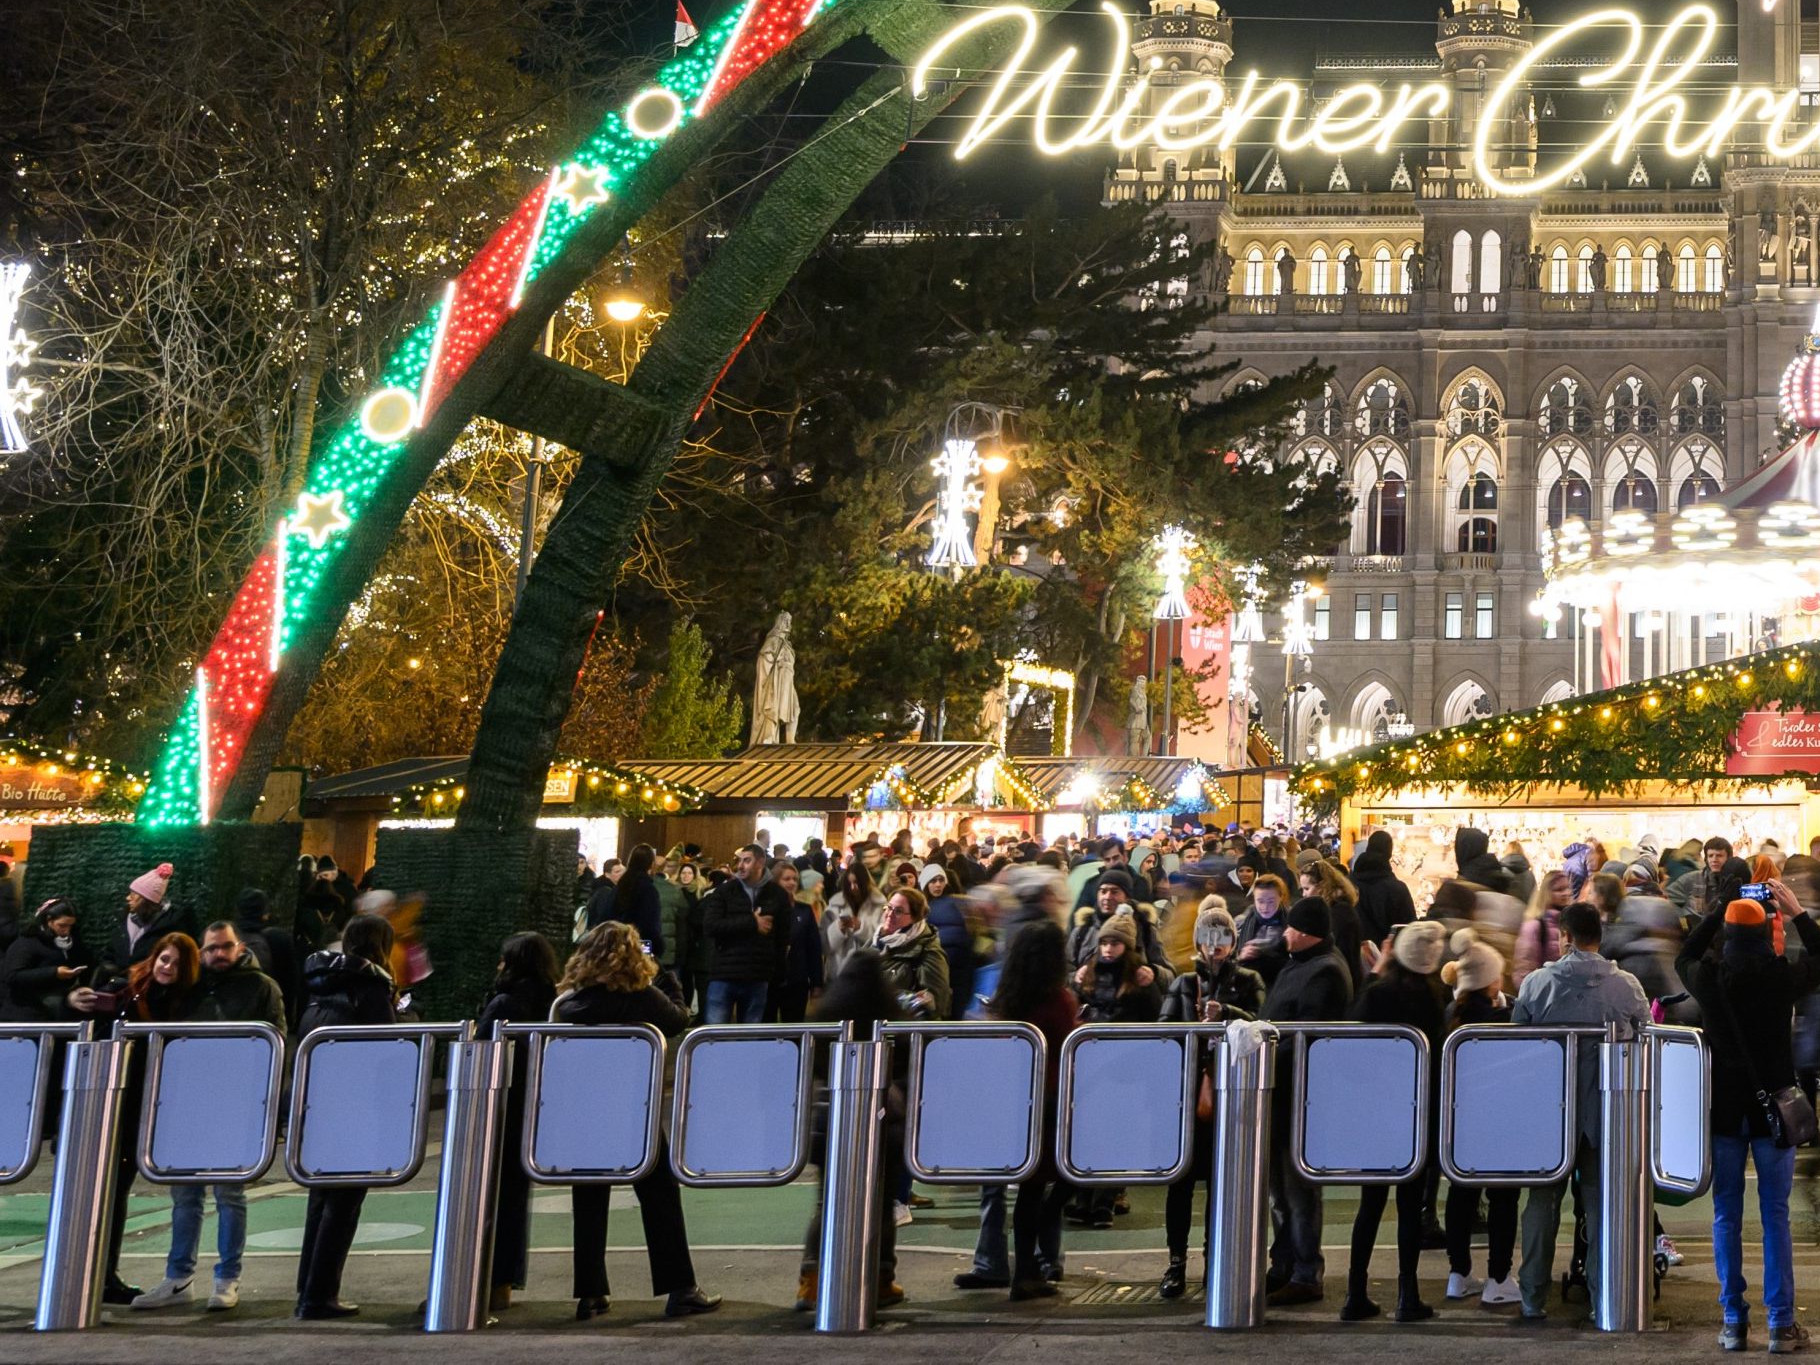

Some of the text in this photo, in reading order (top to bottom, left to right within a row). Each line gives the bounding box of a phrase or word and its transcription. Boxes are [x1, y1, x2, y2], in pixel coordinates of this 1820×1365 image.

[911, 0, 1451, 161] Wiener
[1204, 628, 1224, 639] Stadt
[1203, 639, 1224, 651] Wien
[1774, 718, 1815, 733] Tiroler
[1771, 734, 1804, 748] edles
[1, 780, 67, 802] Bio Hütte
